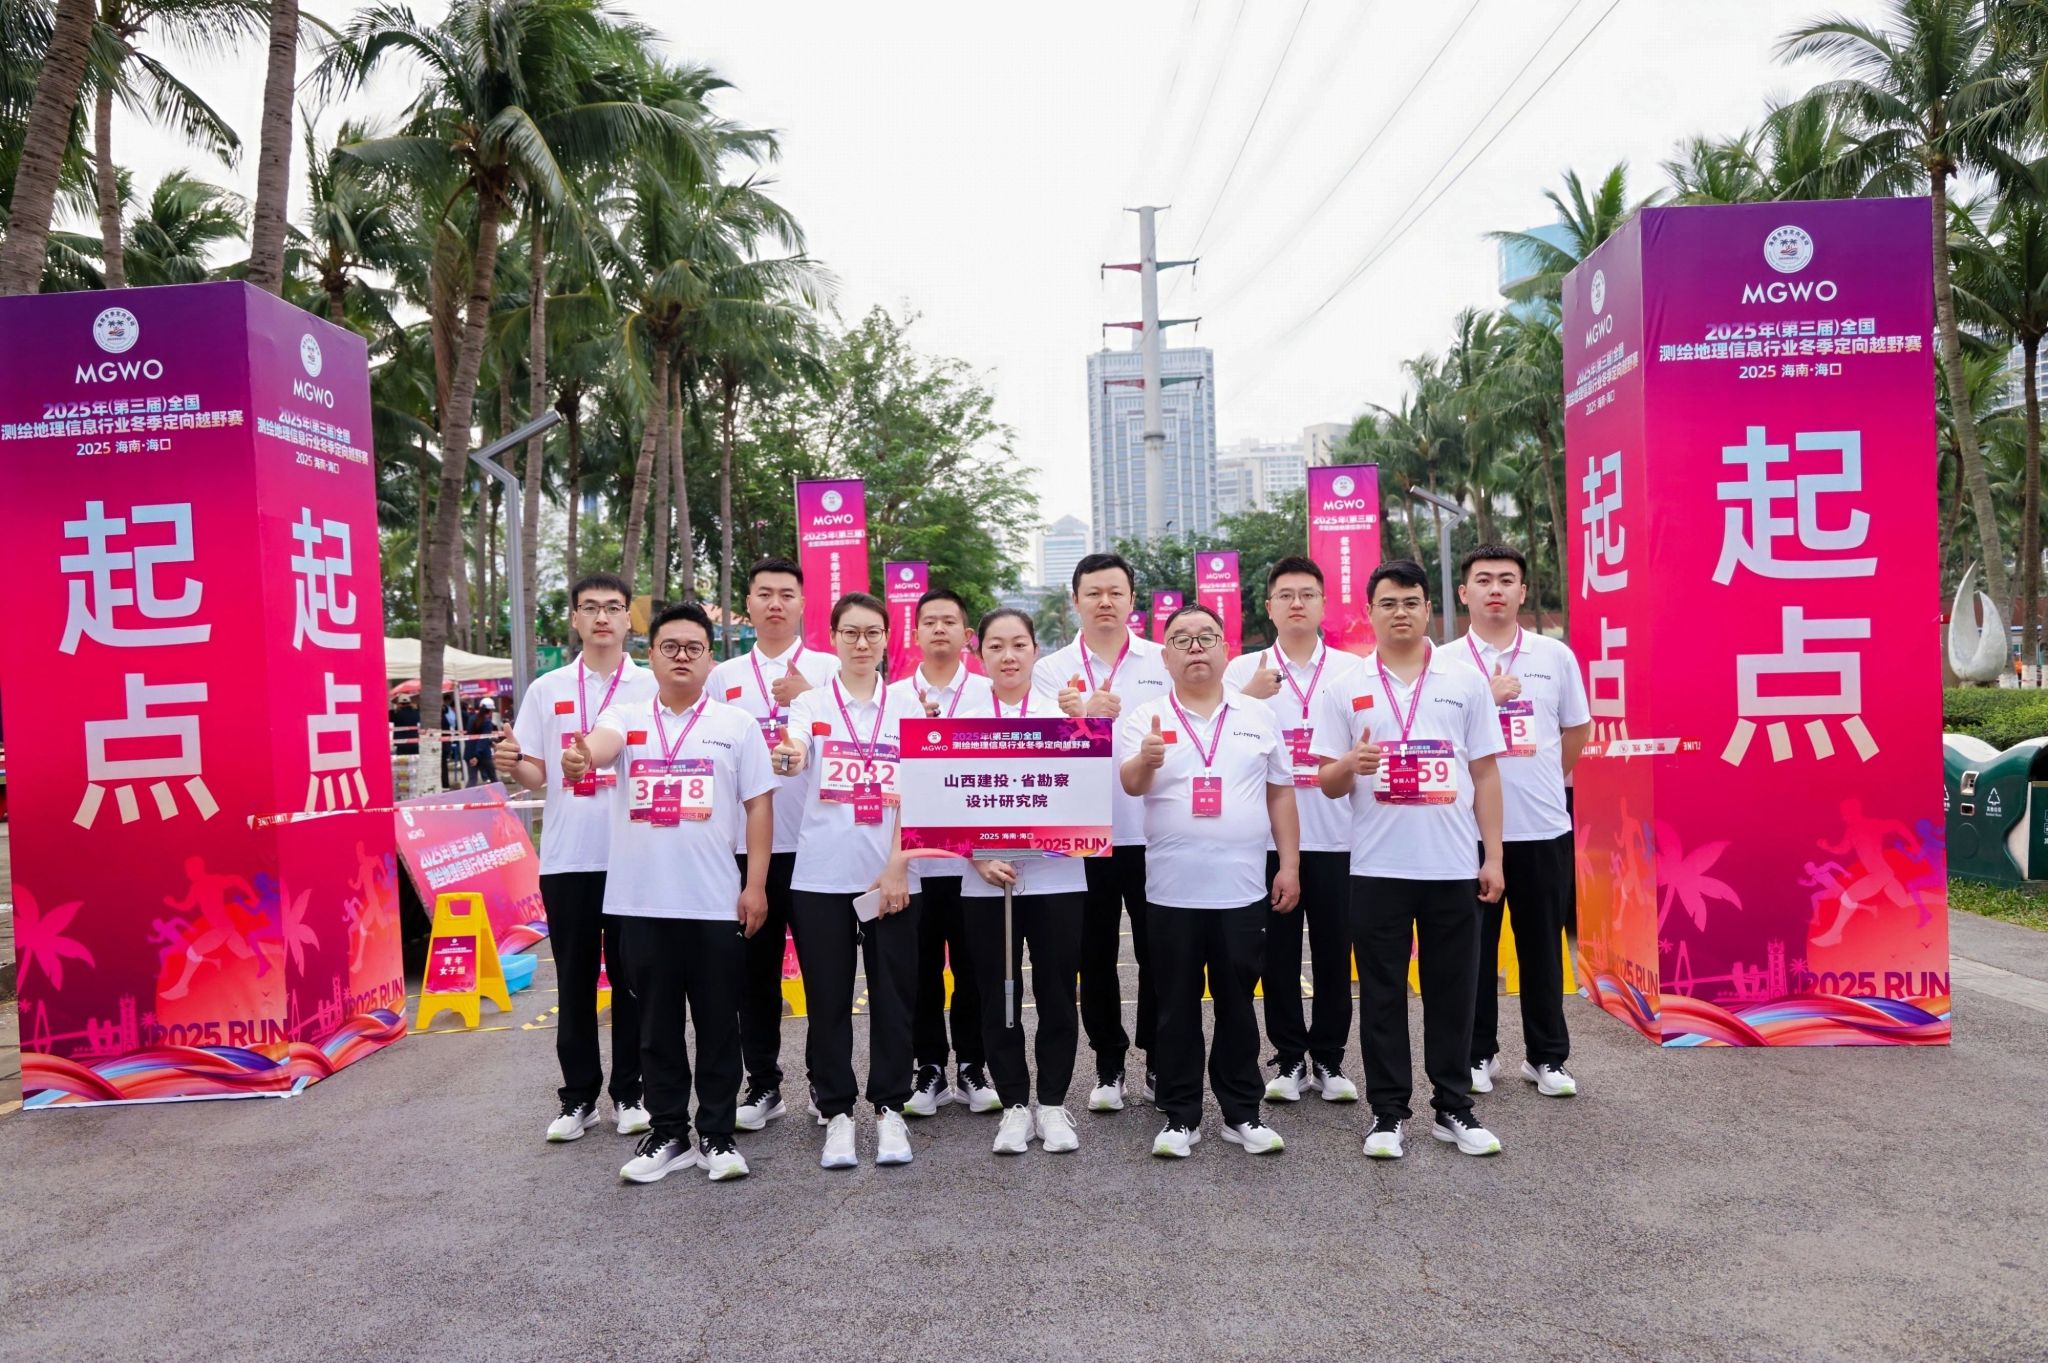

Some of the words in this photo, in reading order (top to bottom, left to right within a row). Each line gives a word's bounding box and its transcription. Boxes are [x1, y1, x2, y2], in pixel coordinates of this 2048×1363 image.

[1741, 280, 1837, 304] MGWO
[1585, 314, 1613, 349] MGWO
[1705, 318, 1876, 341] 2025年(第三届)全国
[1659, 335, 1922, 362] 测绘地理信息行业冬季定向越野赛
[75, 359, 164, 384] MGWO
[1739, 365, 1776, 379] 2025
[1781, 363, 1842, 378] 海南·海口
[293, 378, 334, 408] MGWO
[42, 394, 200, 420] 2025年(第三届)全国
[1, 410, 244, 440] 测绘地理信息行业冬季定向越野赛
[76, 442, 111, 456] 2025
[115, 438, 171, 454] 海南·海口
[296, 452, 313, 467] 2025
[1323, 498, 1365, 511] MGWO
[813, 513, 853, 526] MGWO
[894, 582, 920, 590] MGWO
[1206, 572, 1231, 580] MGWO
[1581, 449, 1629, 763] 起点
[1712, 425, 1880, 767] 起点
[59, 500, 220, 830] 起点
[292, 506, 370, 812] 起点
[952, 731, 1042, 741] 2025年(第三届)全国
[944, 773, 1070, 788] 山西建投·省勘察
[1381, 760, 1449, 783] 359
[636, 778, 704, 800] 38
[966, 794, 1048, 808] 设计研究院
[980, 832, 999, 840] 2025
[1035, 838, 1071, 850] 2025
[1075, 838, 1107, 850] RUN
[1635, 963, 1659, 996] RUN
[1884, 971, 1949, 999] RUN
[380, 977, 403, 1010] RUN
[228, 1019, 288, 1046] RUN
